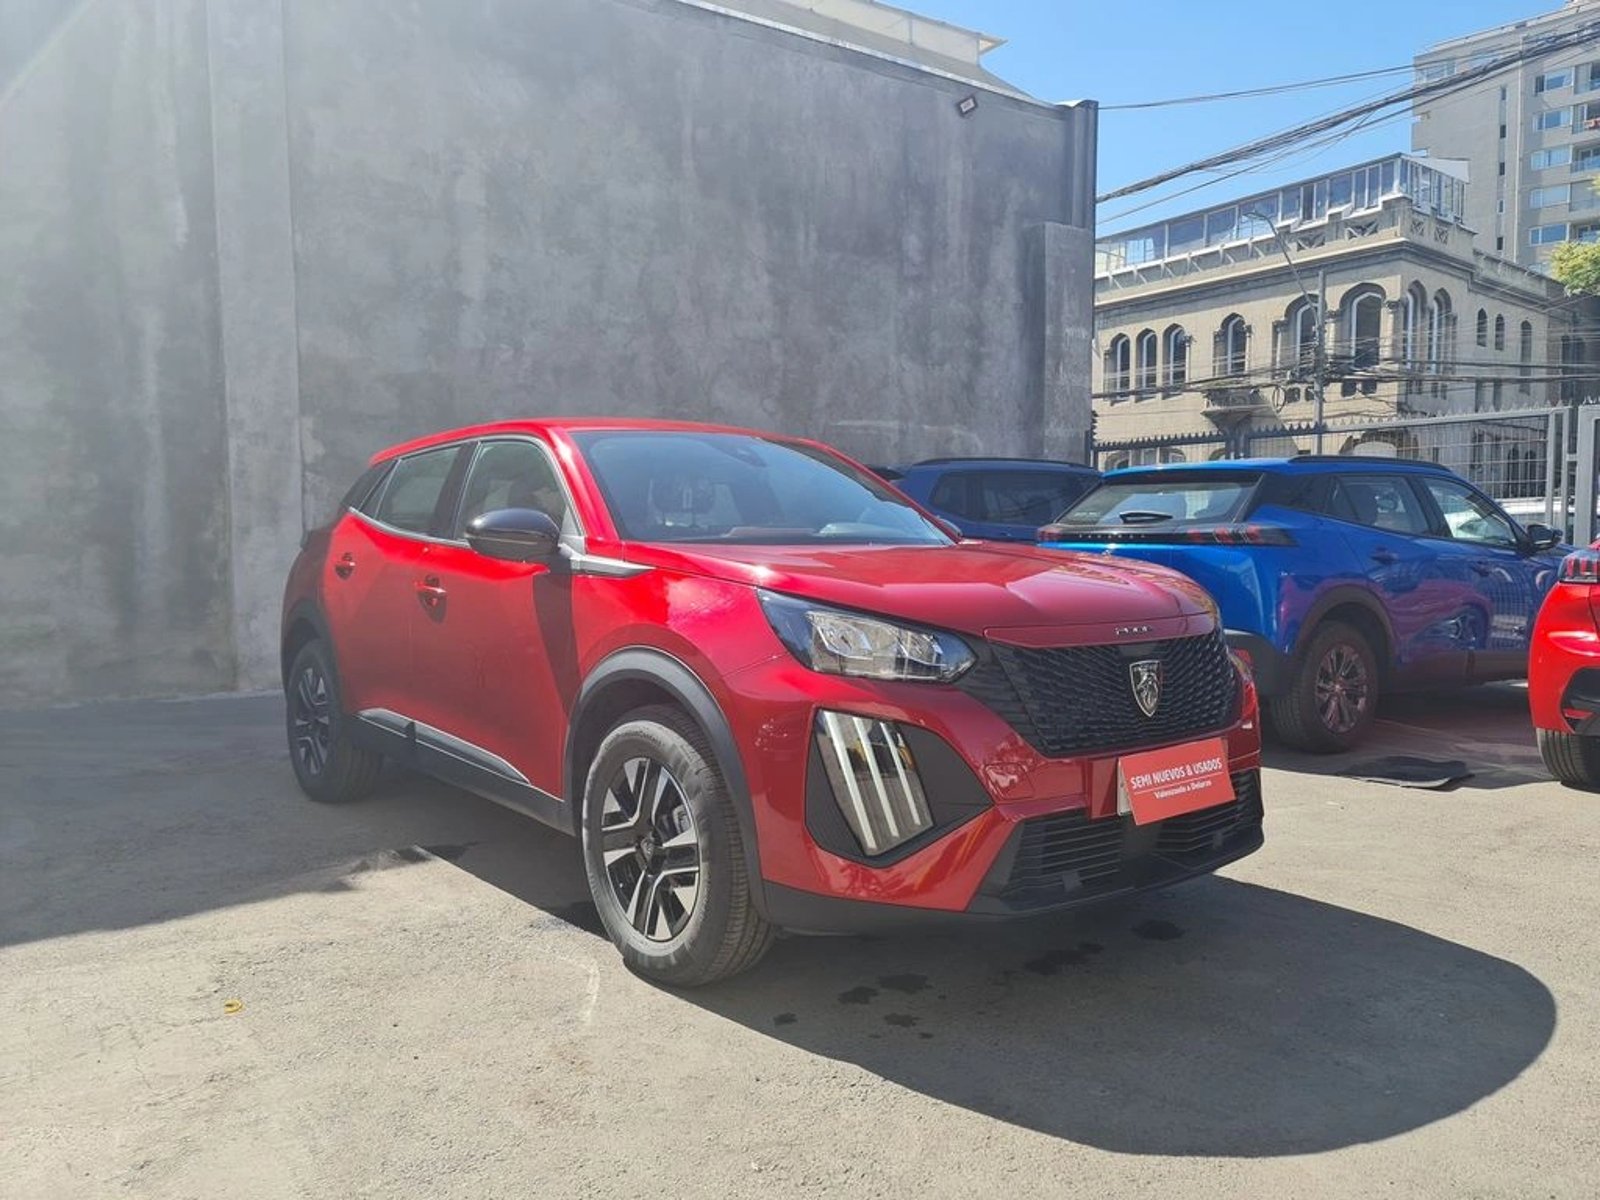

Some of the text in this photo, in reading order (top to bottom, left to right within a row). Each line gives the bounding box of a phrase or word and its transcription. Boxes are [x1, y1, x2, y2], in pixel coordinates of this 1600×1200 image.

[1131, 758, 1222, 789] SEMI NUEVOS & USADOS
